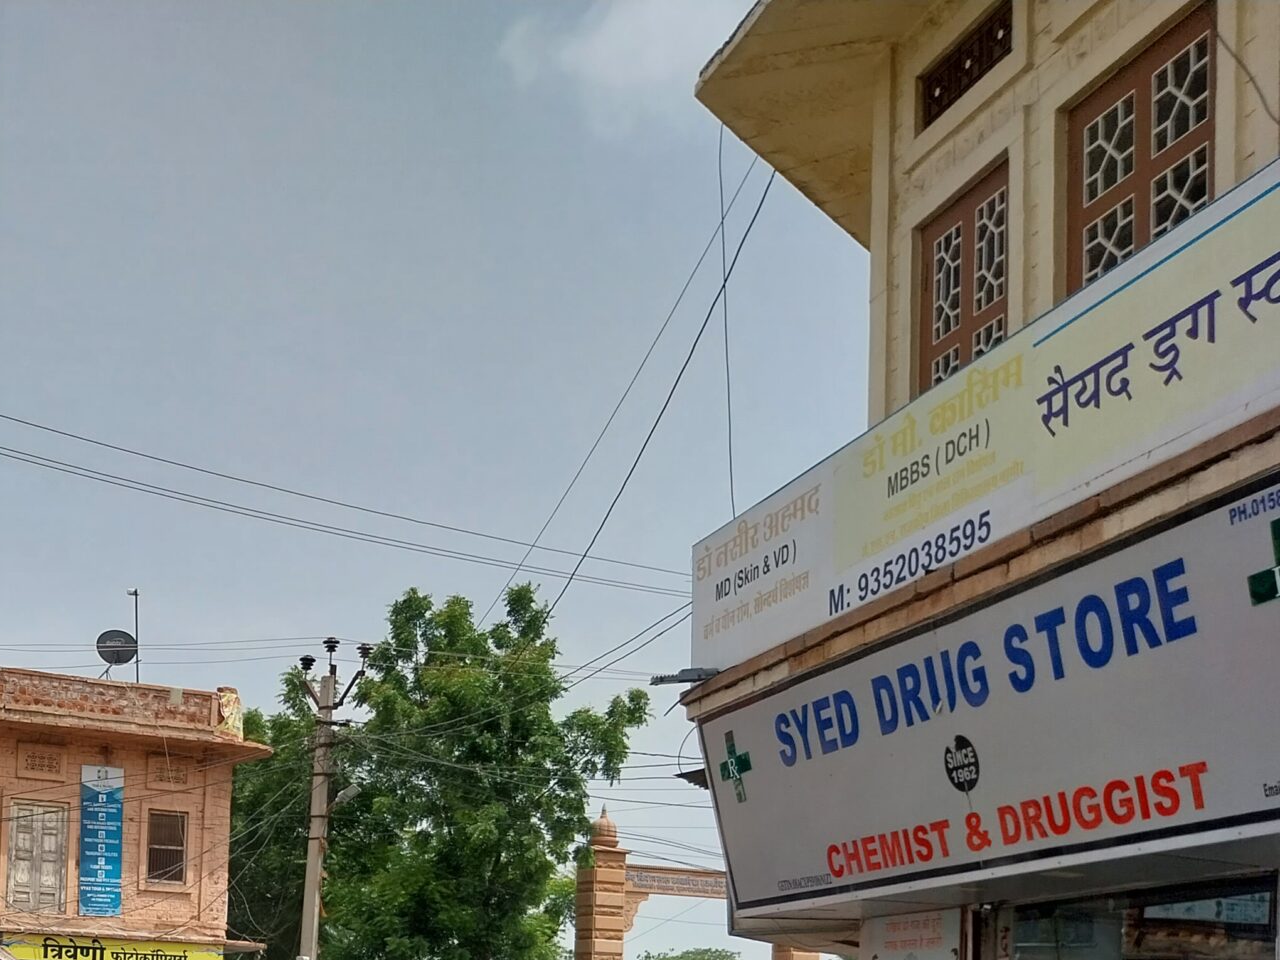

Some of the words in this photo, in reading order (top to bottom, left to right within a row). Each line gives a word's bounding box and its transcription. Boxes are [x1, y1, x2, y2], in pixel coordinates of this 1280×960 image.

[1036, 343, 1135, 438] सैयद
[1142, 289, 1222, 386] ड्रग
[887, 453, 931, 499] MBBS
[945, 423, 980, 466] DCH
[715, 578, 732, 602] MD
[733, 563, 760, 596] (Skin
[762, 554, 771, 575] &
[829, 584, 851, 616] M:
[857, 509, 992, 601] 9352038595
[774, 689, 860, 768] SYED
[871, 641, 990, 736] DRUG
[1003, 557, 1198, 694] STORE
[946, 746, 976, 770] SINCE
[951, 765, 978, 784] 1962
[827, 819, 951, 879] CHEMIST
[965, 812, 992, 852] &
[997, 761, 1209, 846] DRUGGIST
